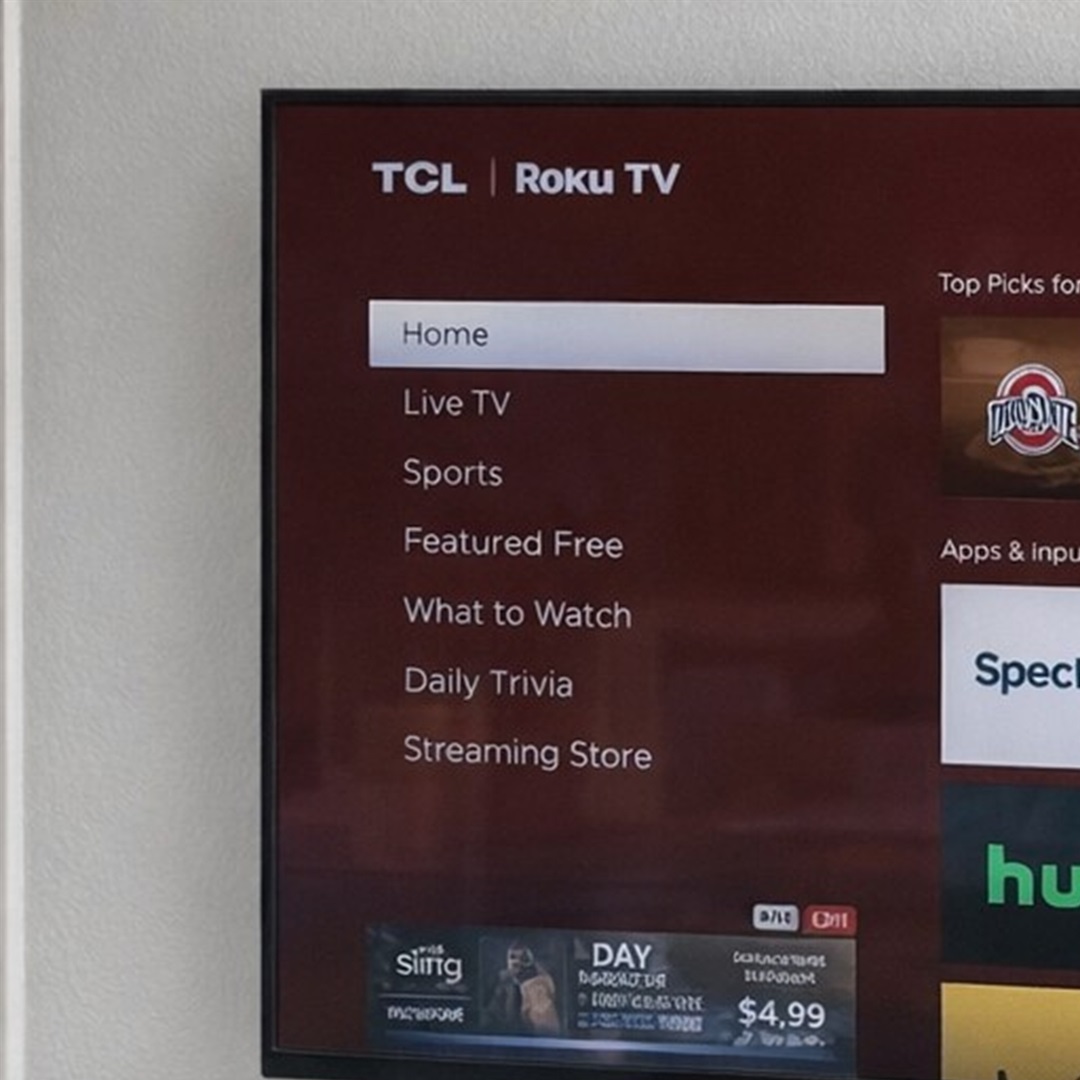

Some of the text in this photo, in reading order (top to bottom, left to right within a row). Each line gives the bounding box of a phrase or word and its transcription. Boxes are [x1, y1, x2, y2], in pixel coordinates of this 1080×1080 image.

[371, 160, 681, 195] TCL Roku TV
[938, 272, 981, 297] Top
[987, 272, 1045, 295] Picks
[403, 322, 489, 347] Home
[404, 388, 511, 417] Live TV
[403, 457, 503, 490] Sports
[404, 526, 624, 559] Featured Free
[940, 538, 1002, 564] Apps
[1008, 540, 1025, 562] &
[403, 596, 632, 629] What to Watch
[405, 666, 573, 701] Daily Trivia
[404, 734, 653, 772] Streaming Store
[592, 942, 652, 969] DAY
